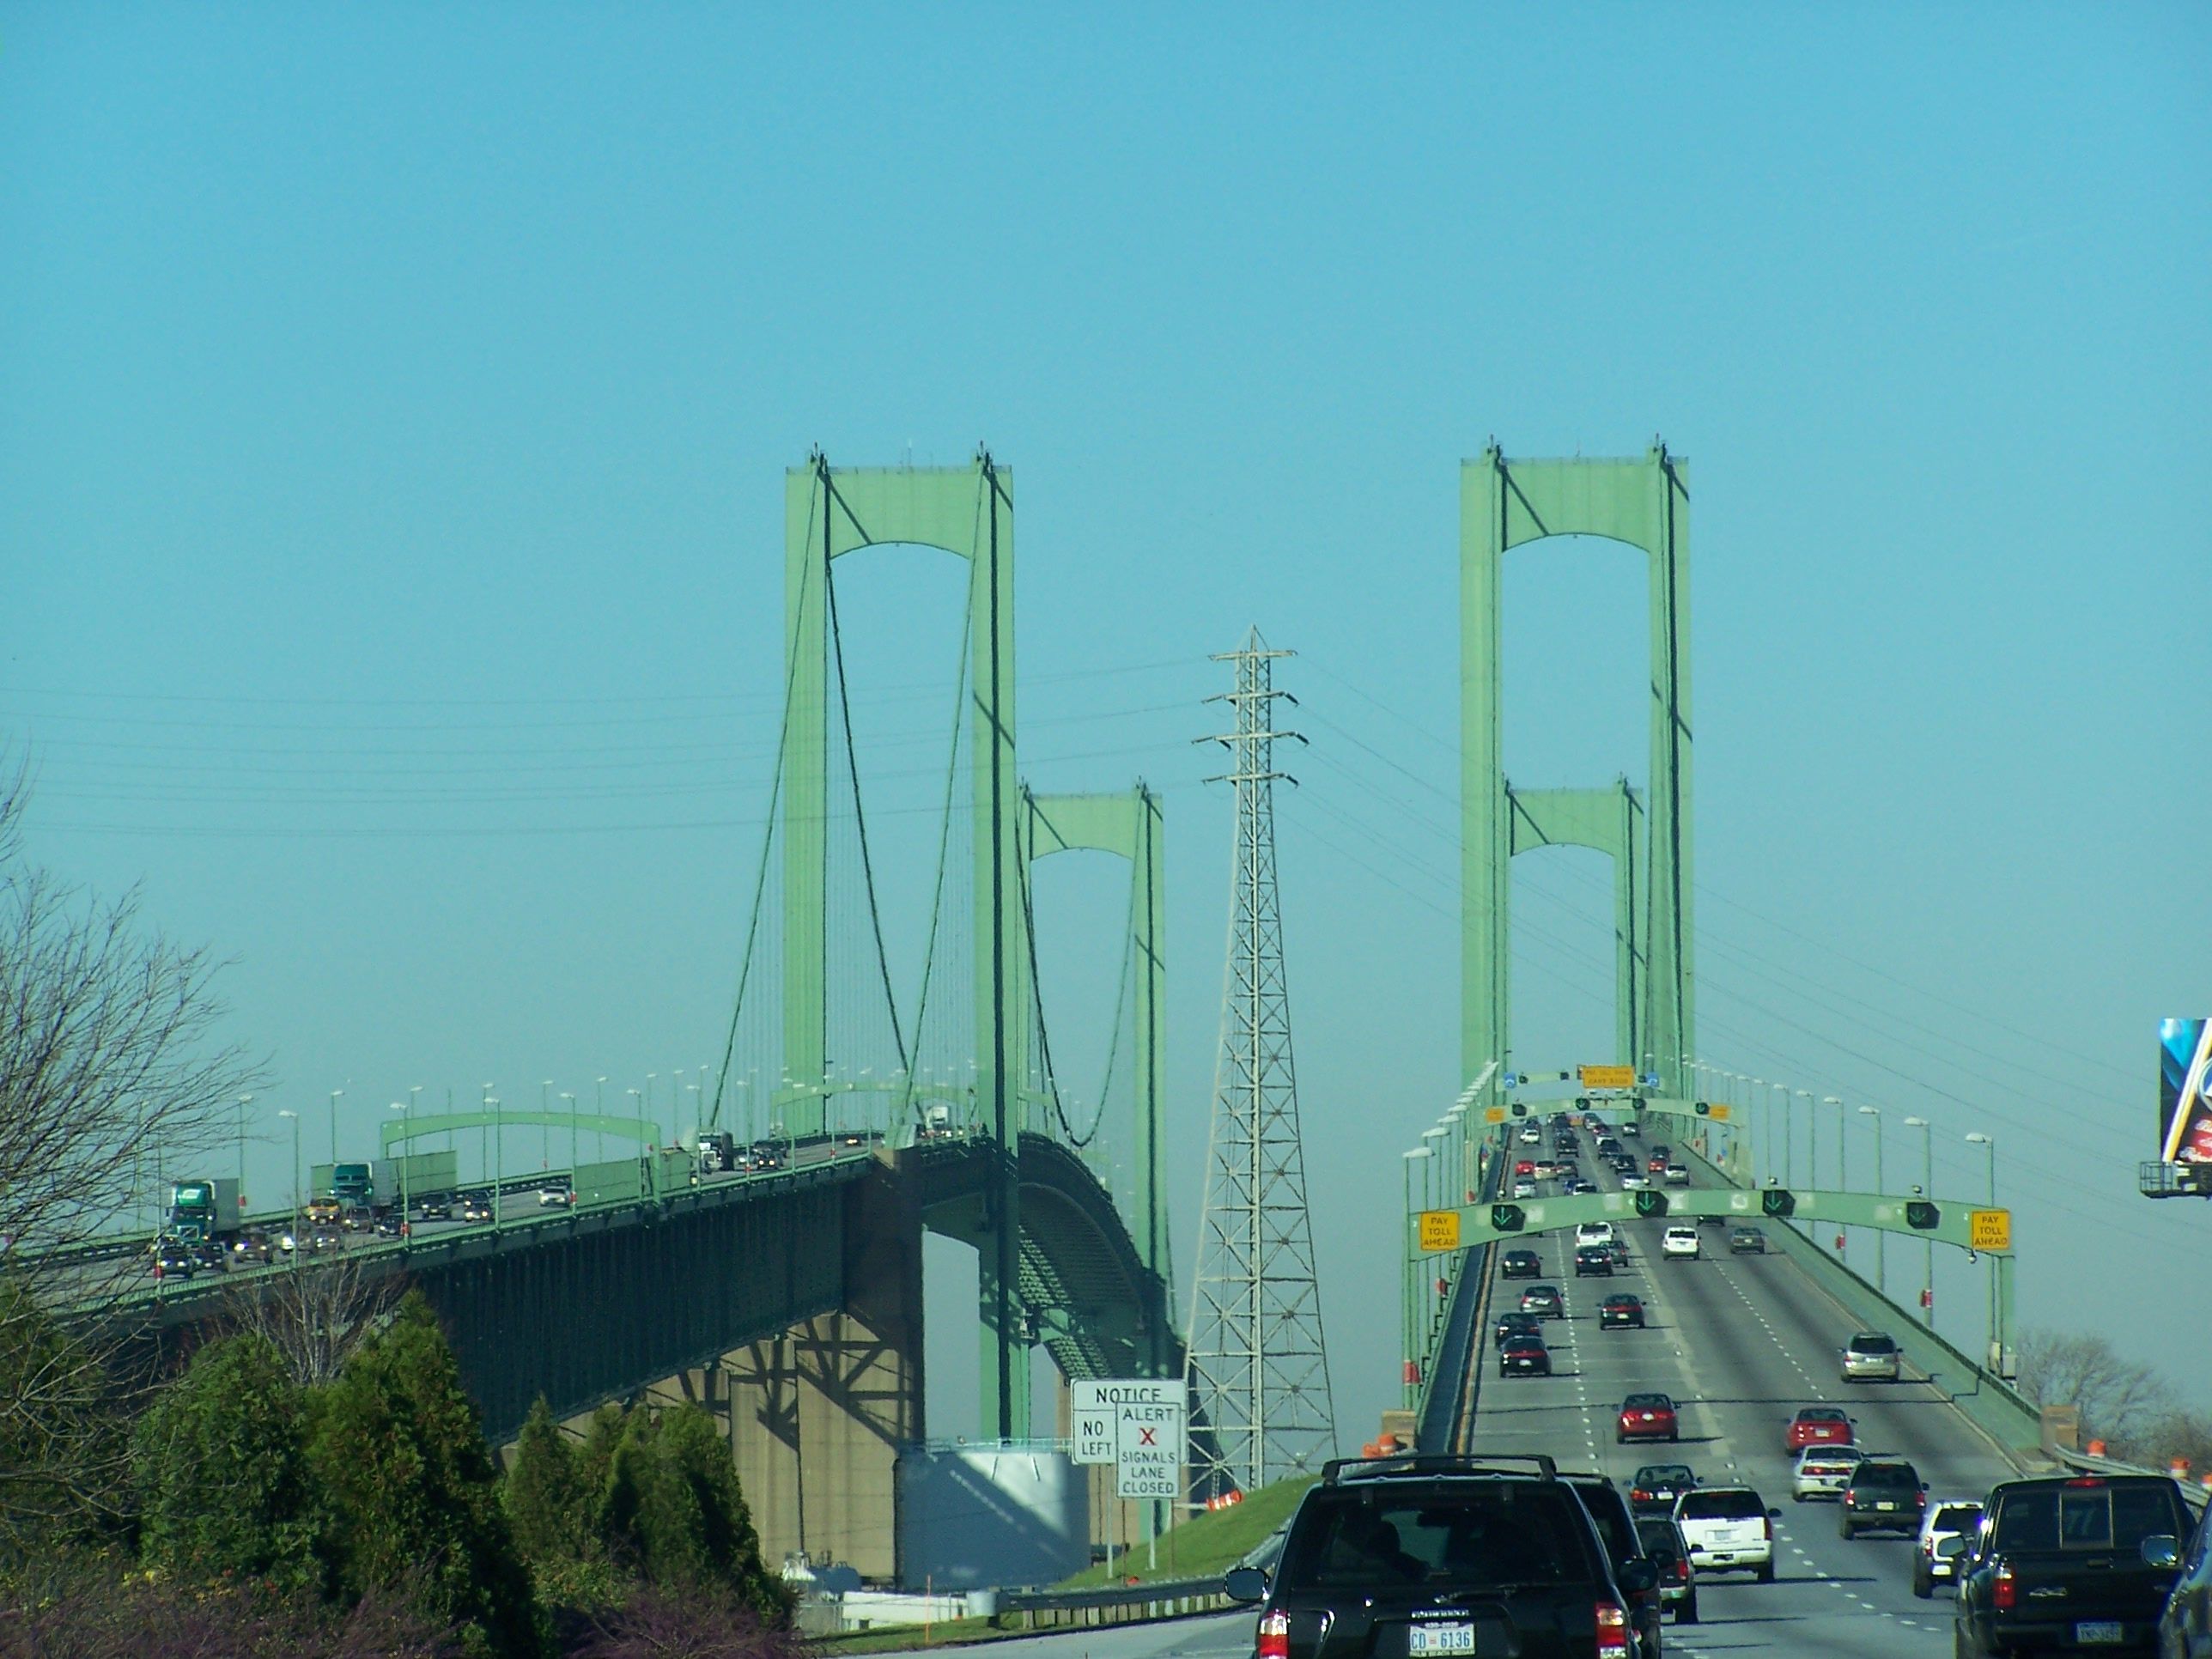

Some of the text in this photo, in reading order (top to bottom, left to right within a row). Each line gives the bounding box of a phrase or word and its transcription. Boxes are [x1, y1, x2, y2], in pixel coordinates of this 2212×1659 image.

[1980, 1227, 2002, 1236] TOLL
[1096, 1388, 1161, 1403] NOTICE
[1122, 1408, 1174, 1421] ALERT
[1084, 1421, 1103, 1436] NO
[1082, 1443, 1111, 1455] LEFT
[1121, 1451, 1176, 1463] SIGNALS
[1131, 1468, 1165, 1478] LANE
[1122, 1481, 1174, 1493] CLOSED
[1440, 1632, 1471, 1648] 6136
